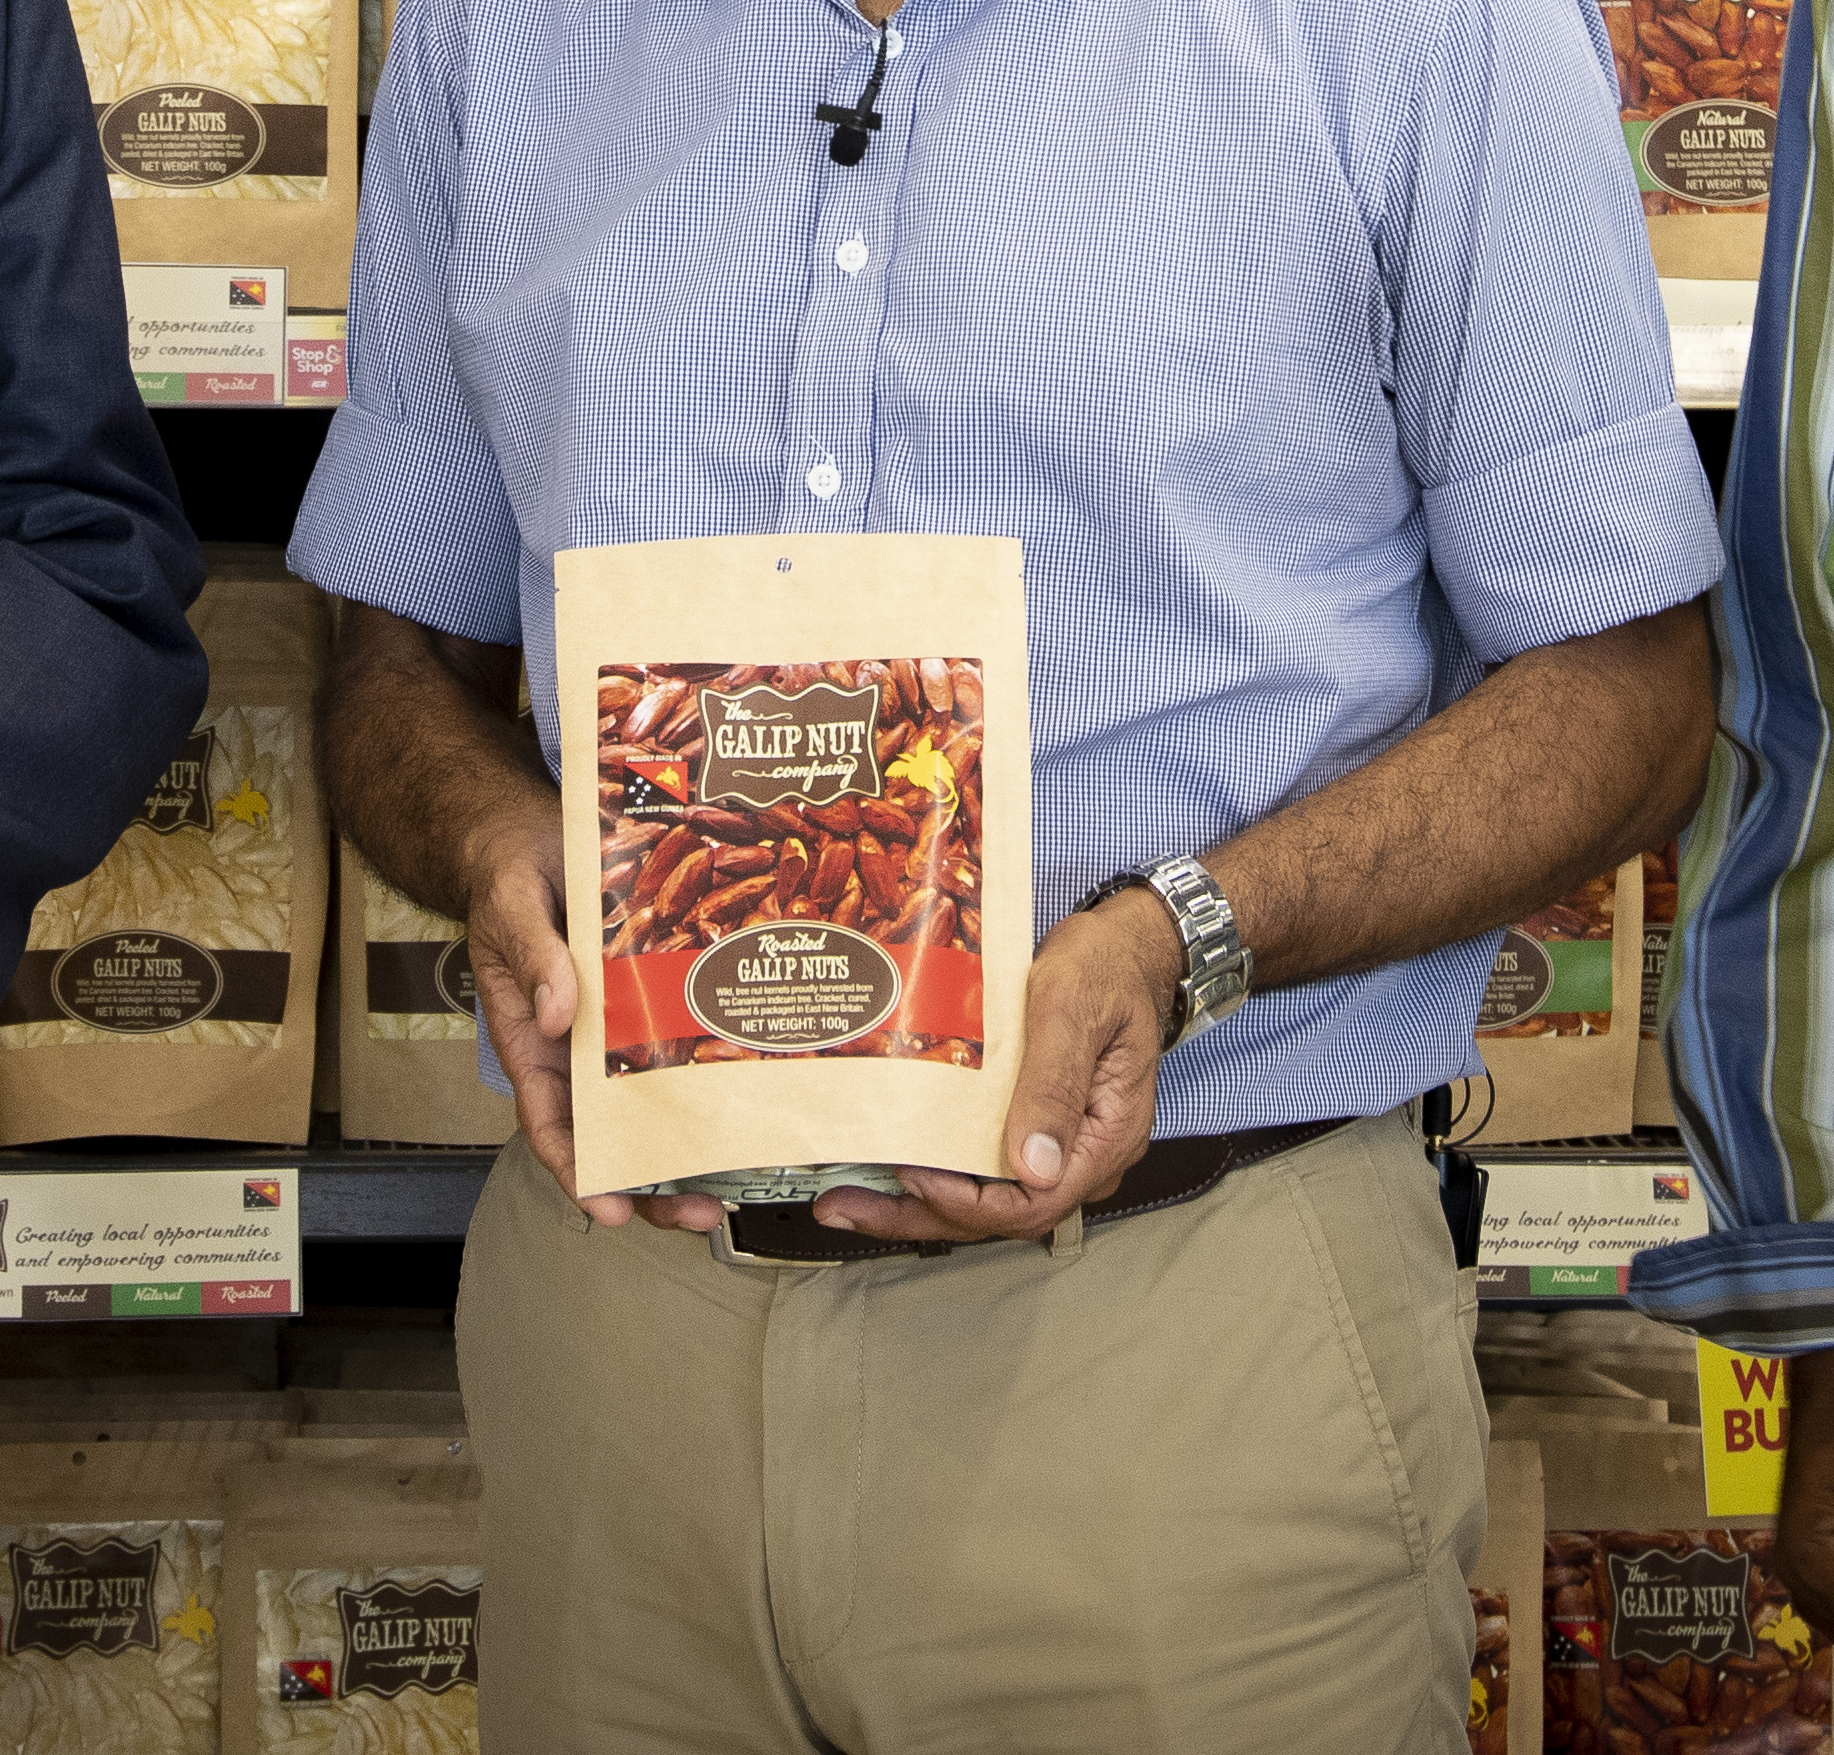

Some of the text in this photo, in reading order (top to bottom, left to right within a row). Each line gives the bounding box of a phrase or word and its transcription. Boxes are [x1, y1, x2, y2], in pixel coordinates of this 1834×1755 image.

[138, 112, 226, 132] GALIP NUTS
[1680, 129, 1766, 149] GALIP NUTS
[139, 321, 255, 339] opportunities
[158, 344, 265, 358] communities
[292, 347, 324, 363] Stop
[297, 361, 334, 374] Shop
[716, 721, 865, 759] GALIP NUT
[772, 755, 858, 792] company
[758, 931, 828, 958] Roasted
[93, 958, 182, 977] GALIP NUTS
[738, 955, 850, 983] GALIP NUTS
[791, 984, 817, 996] proudly
[819, 984, 855, 994] harvested
[856, 984, 874, 993] from
[760, 1005, 796, 1017] packaged
[805, 1004, 821, 1014] East
[822, 1004, 839, 1013] New
[741, 1017, 849, 1033] NET WEIGHT: 100g
[1519, 1211, 1562, 1227] local
[1568, 1214, 1681, 1233] opportunities
[16, 1223, 271, 1247] Creating local opportunities
[16, 1249, 283, 1272] and empowering communities
[1551, 1269, 1600, 1284] Natural
[45, 1284, 274, 1304] Peeled Natural Roasted
[1731, 1358, 1790, 1402] W
[1724, 1407, 1788, 1453] BU
[24, 1577, 145, 1610] GALIP NUT
[1622, 1586, 1740, 1618] GALIP NUT
[353, 1617, 472, 1653] GALIP NUT
